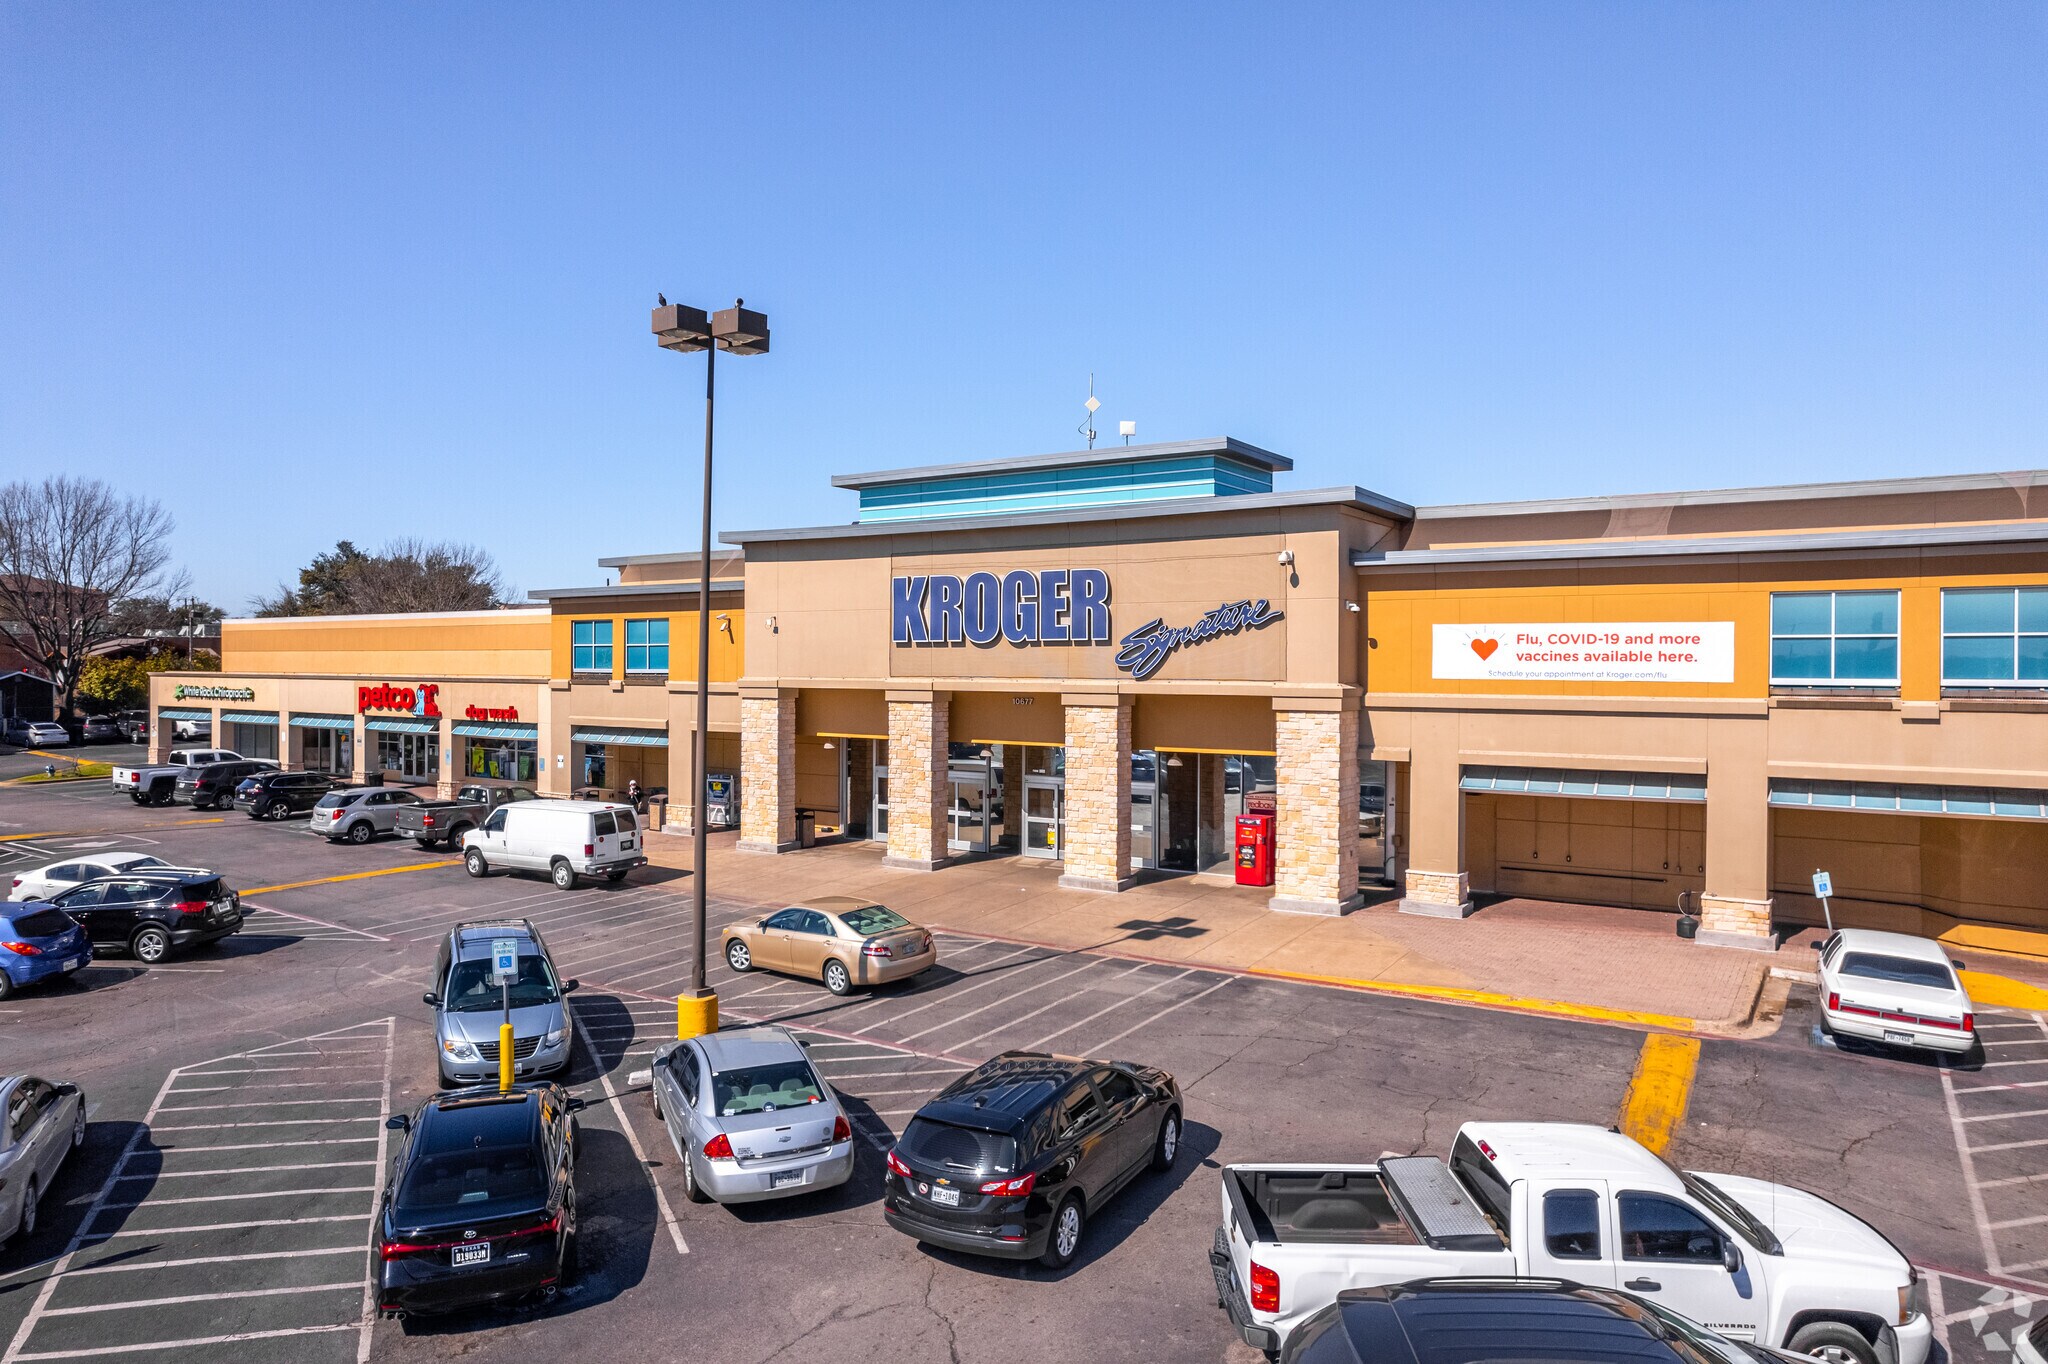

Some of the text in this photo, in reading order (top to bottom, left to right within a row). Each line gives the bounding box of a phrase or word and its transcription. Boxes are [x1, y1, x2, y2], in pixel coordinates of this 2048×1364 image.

[892, 568, 1110, 644] KROGER
[1114, 598, 1283, 680] Signature
[1516, 633, 1701, 647] Flu, COVID-19 and more
[1516, 650, 1698, 662] vaccines available here.
[1525, 671, 1542, 679] your
[1543, 671, 1594, 679] appointment
[1606, 671, 1668, 679] Kroger.com/flu
[183, 684, 252, 700] White Rock Chiropractic
[358, 682, 417, 714] petco
[1012, 697, 1034, 705] 10677
[465, 704, 519, 721] dog wash
